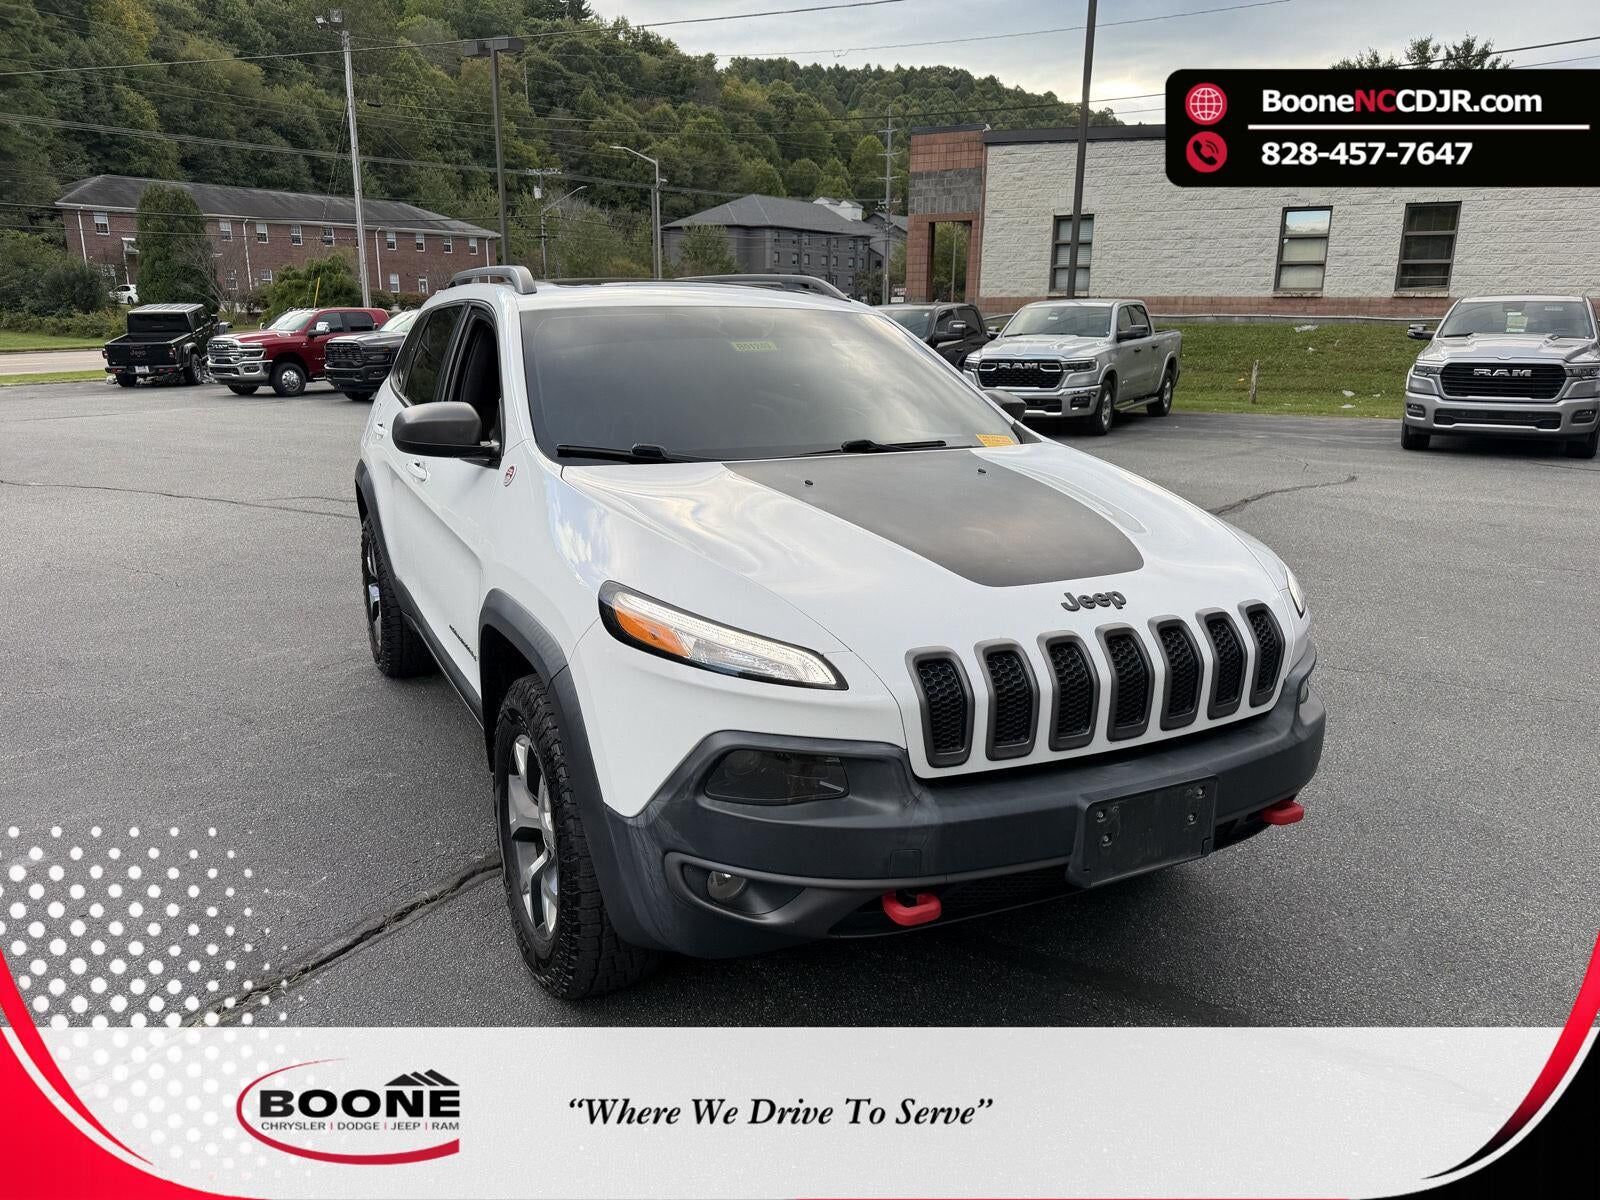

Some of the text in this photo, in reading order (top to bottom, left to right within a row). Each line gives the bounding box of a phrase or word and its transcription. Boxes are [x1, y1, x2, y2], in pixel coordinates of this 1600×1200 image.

[998, 362, 1039, 370] RAM
[1473, 368, 1533, 377] RAM
[1061, 590, 1127, 612] Jeep
